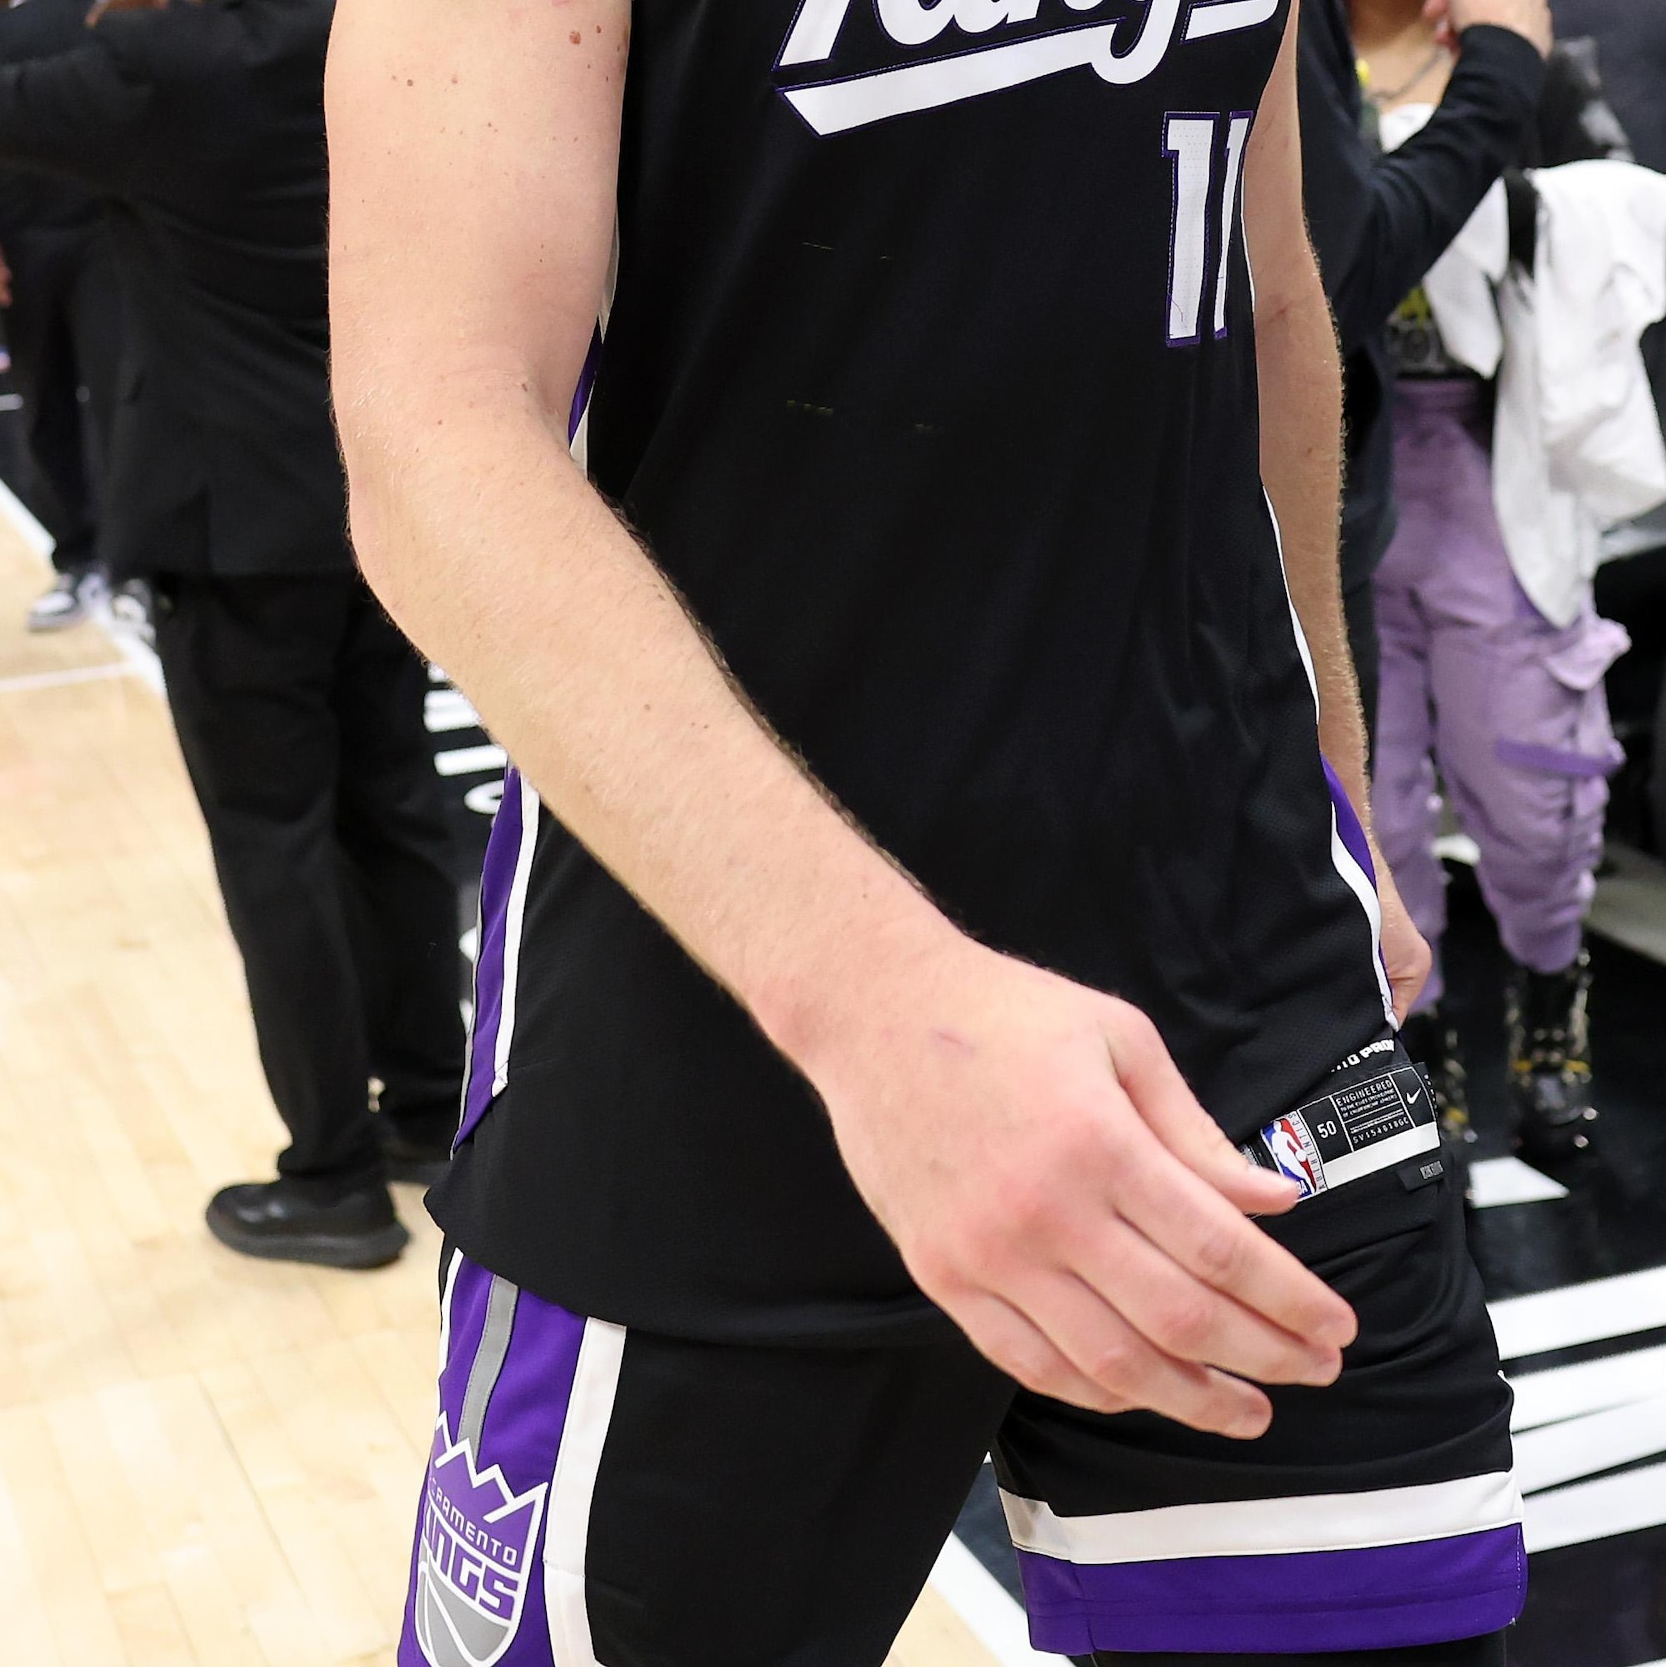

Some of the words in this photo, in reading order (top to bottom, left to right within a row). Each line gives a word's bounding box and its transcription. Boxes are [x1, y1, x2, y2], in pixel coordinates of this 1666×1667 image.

[1162, 111, 1253, 348] 11
[1335, 1079, 1393, 1107] ENGINEERED
[1316, 1120, 1337, 1139] 50
